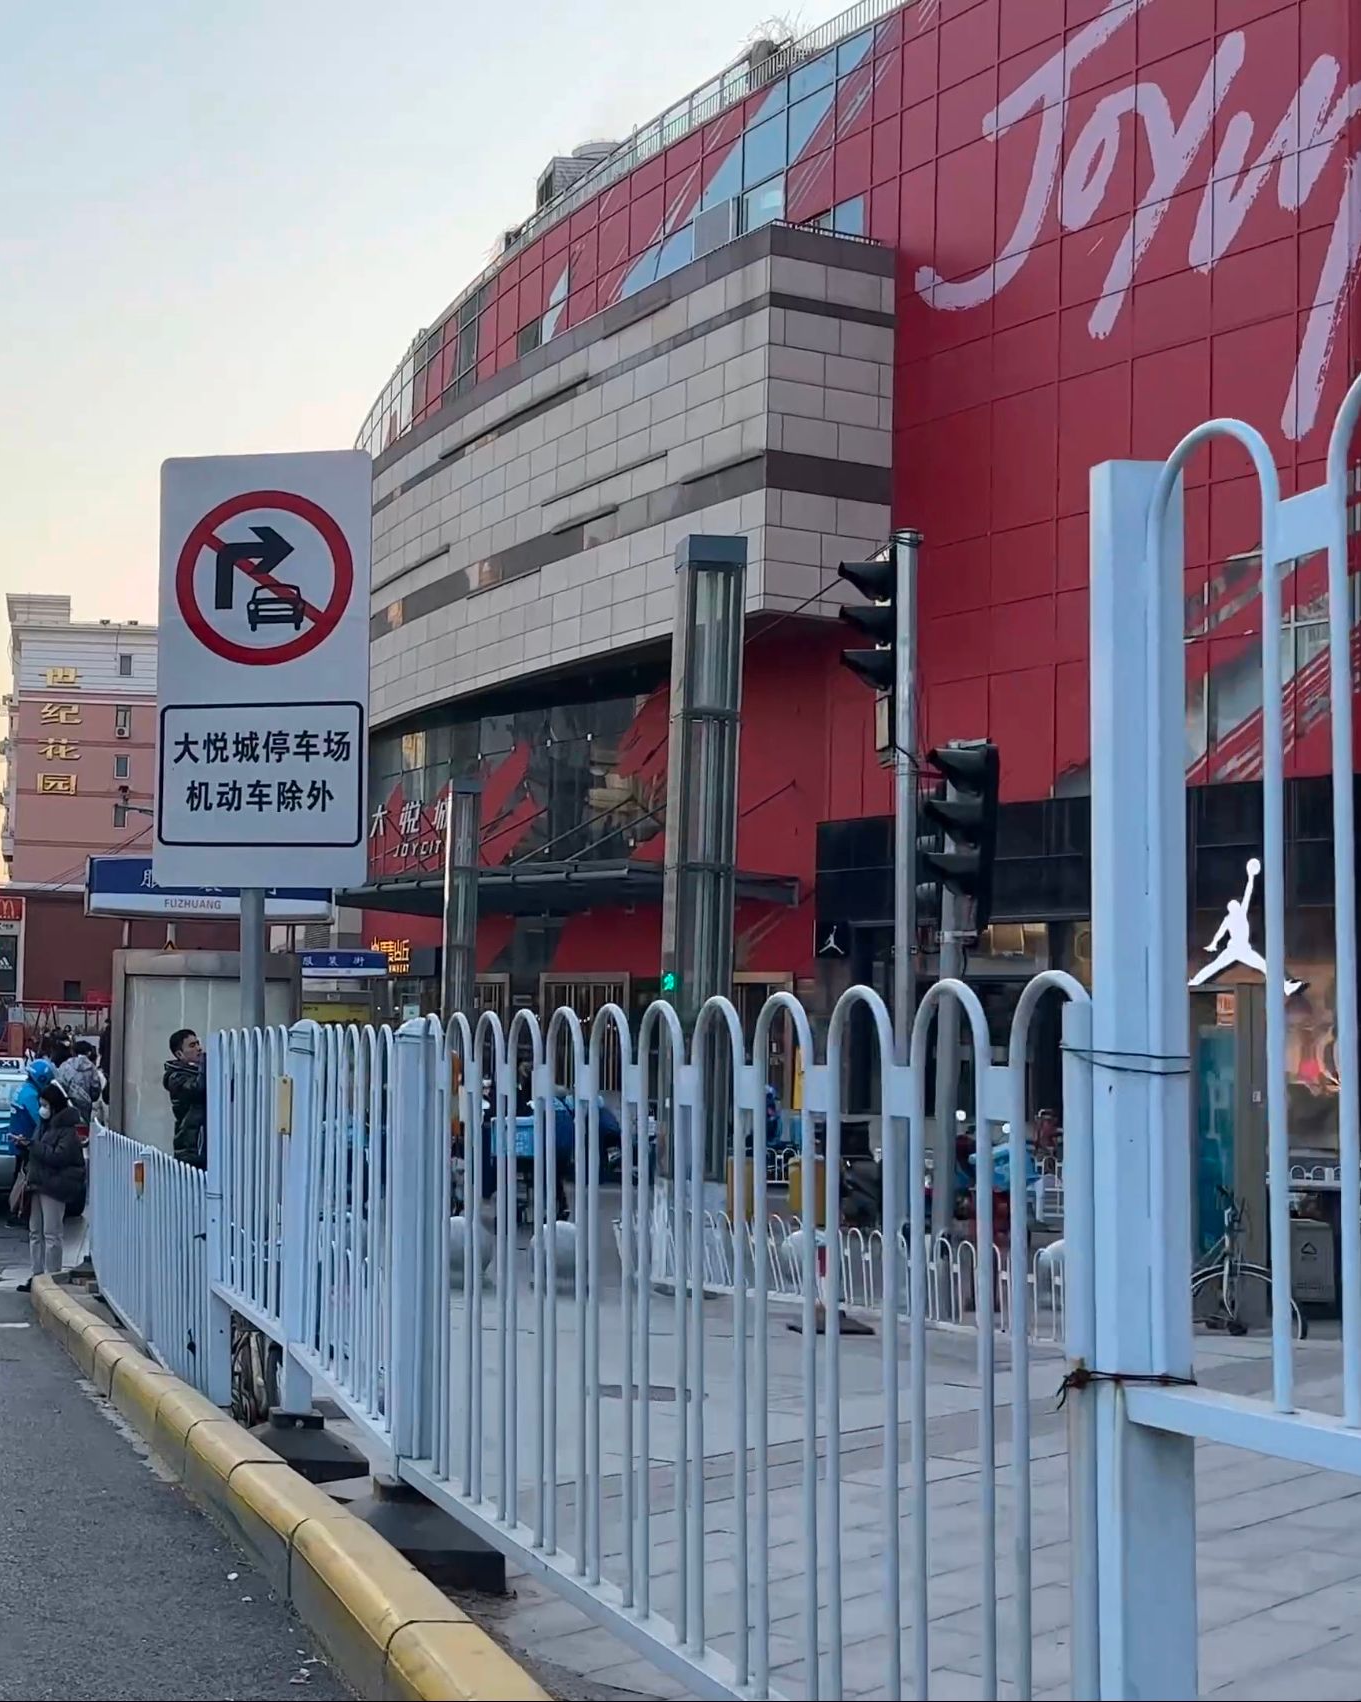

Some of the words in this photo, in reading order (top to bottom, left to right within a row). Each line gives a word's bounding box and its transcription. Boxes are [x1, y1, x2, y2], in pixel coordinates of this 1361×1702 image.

[38, 667, 84, 795] 世纪花园
[173, 730, 351, 764] 大悦城停车场
[186, 780, 335, 812] 机动车除外
[164, 899, 222, 910] FUZHUANG
